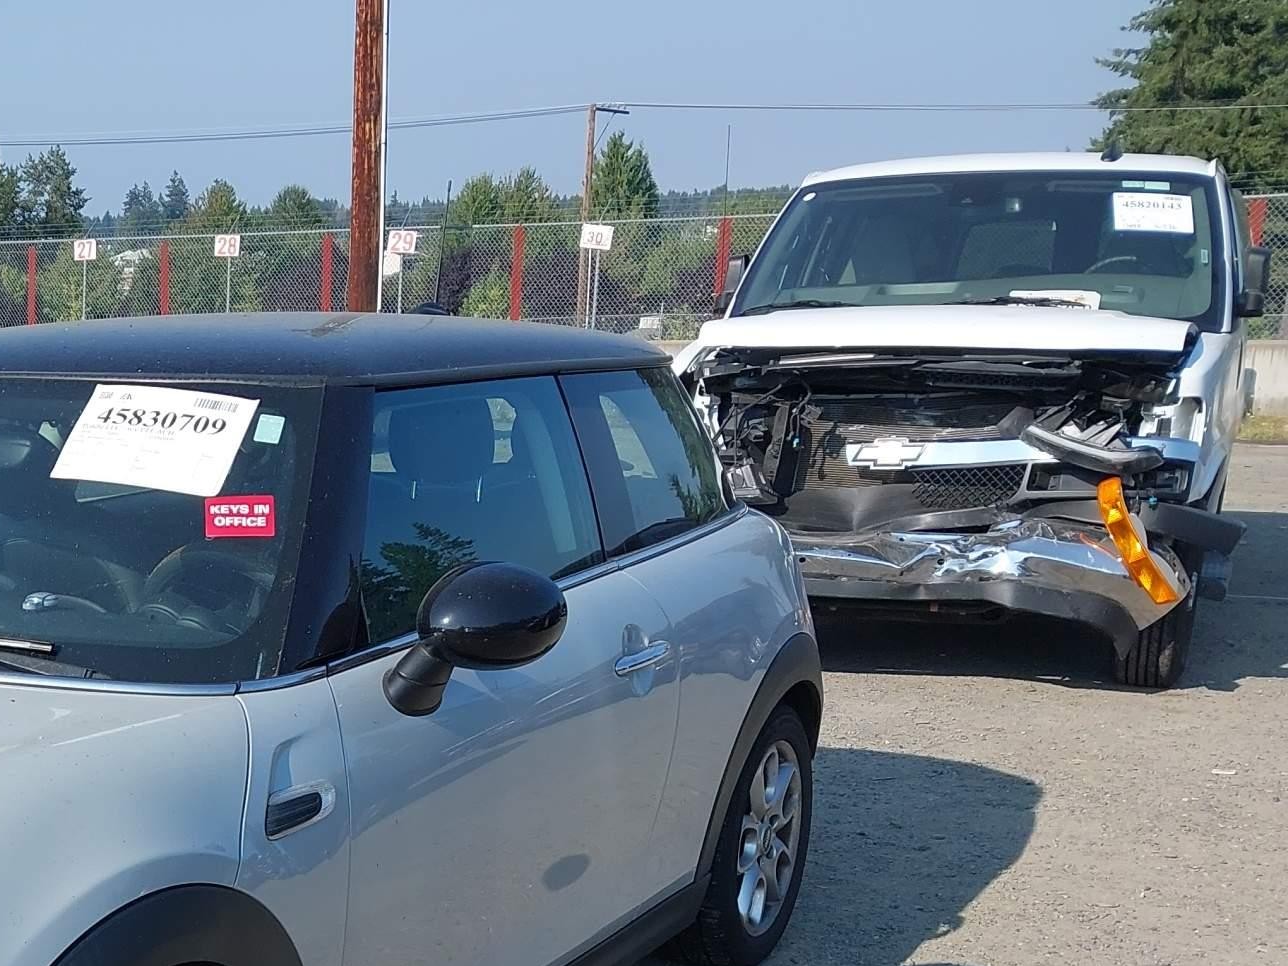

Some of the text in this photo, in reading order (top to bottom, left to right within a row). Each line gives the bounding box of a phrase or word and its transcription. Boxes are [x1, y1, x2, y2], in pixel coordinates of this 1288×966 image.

[1122, 200, 1183, 209] 45820143
[217, 236, 238, 255] 28
[390, 231, 414, 251] 29
[586, 231, 604, 245] 30
[76, 241, 94, 259] 27
[97, 407, 227, 435] 45830709
[209, 503, 270, 515] KEYS IN
[214, 516, 267, 527] OFFICE
